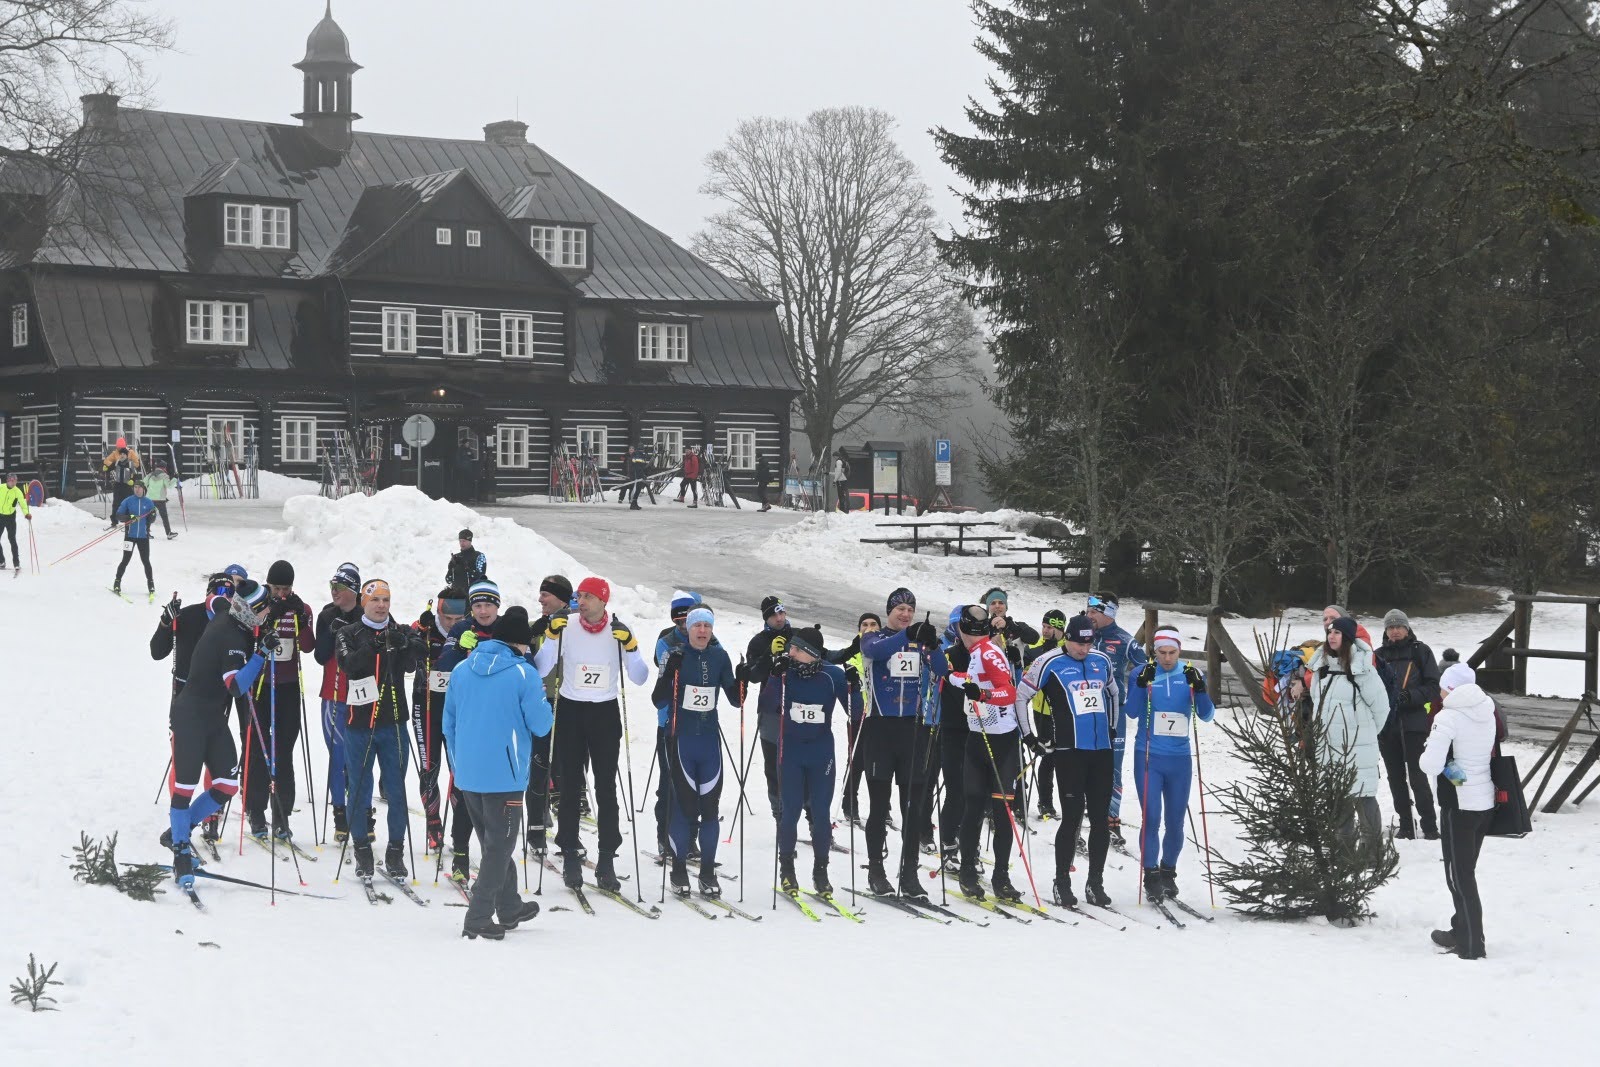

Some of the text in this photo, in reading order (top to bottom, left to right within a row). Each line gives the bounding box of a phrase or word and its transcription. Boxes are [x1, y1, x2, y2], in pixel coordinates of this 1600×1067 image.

[939, 442, 947, 454] P
[900, 660, 913, 671] 21
[584, 672, 600, 684] 27
[355, 687, 366, 700] 11
[693, 694, 709, 706] 23
[1083, 697, 1097, 708] 22
[800, 710, 815, 719] 18
[415, 719, 424, 743] SPARTAK
[1168, 720, 1175, 730] 7
